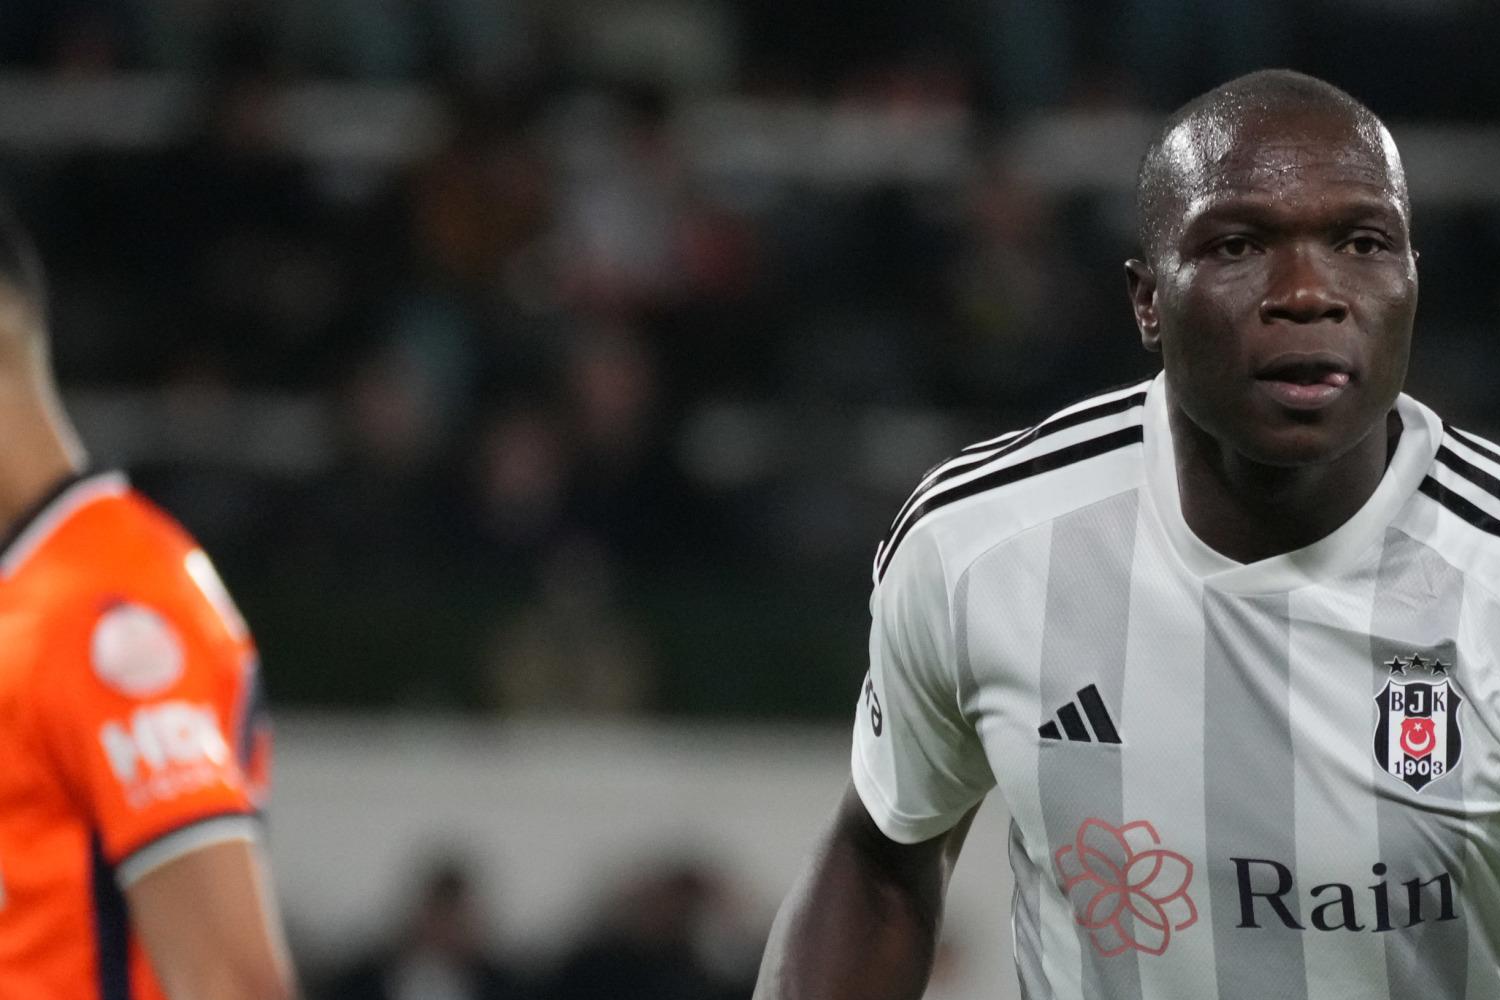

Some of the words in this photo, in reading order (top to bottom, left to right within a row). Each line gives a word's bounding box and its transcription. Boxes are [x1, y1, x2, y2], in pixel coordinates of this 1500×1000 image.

[1391, 690, 1446, 713] BJK
[1394, 760, 1443, 776] 1903
[1229, 857, 1460, 933] Rain
